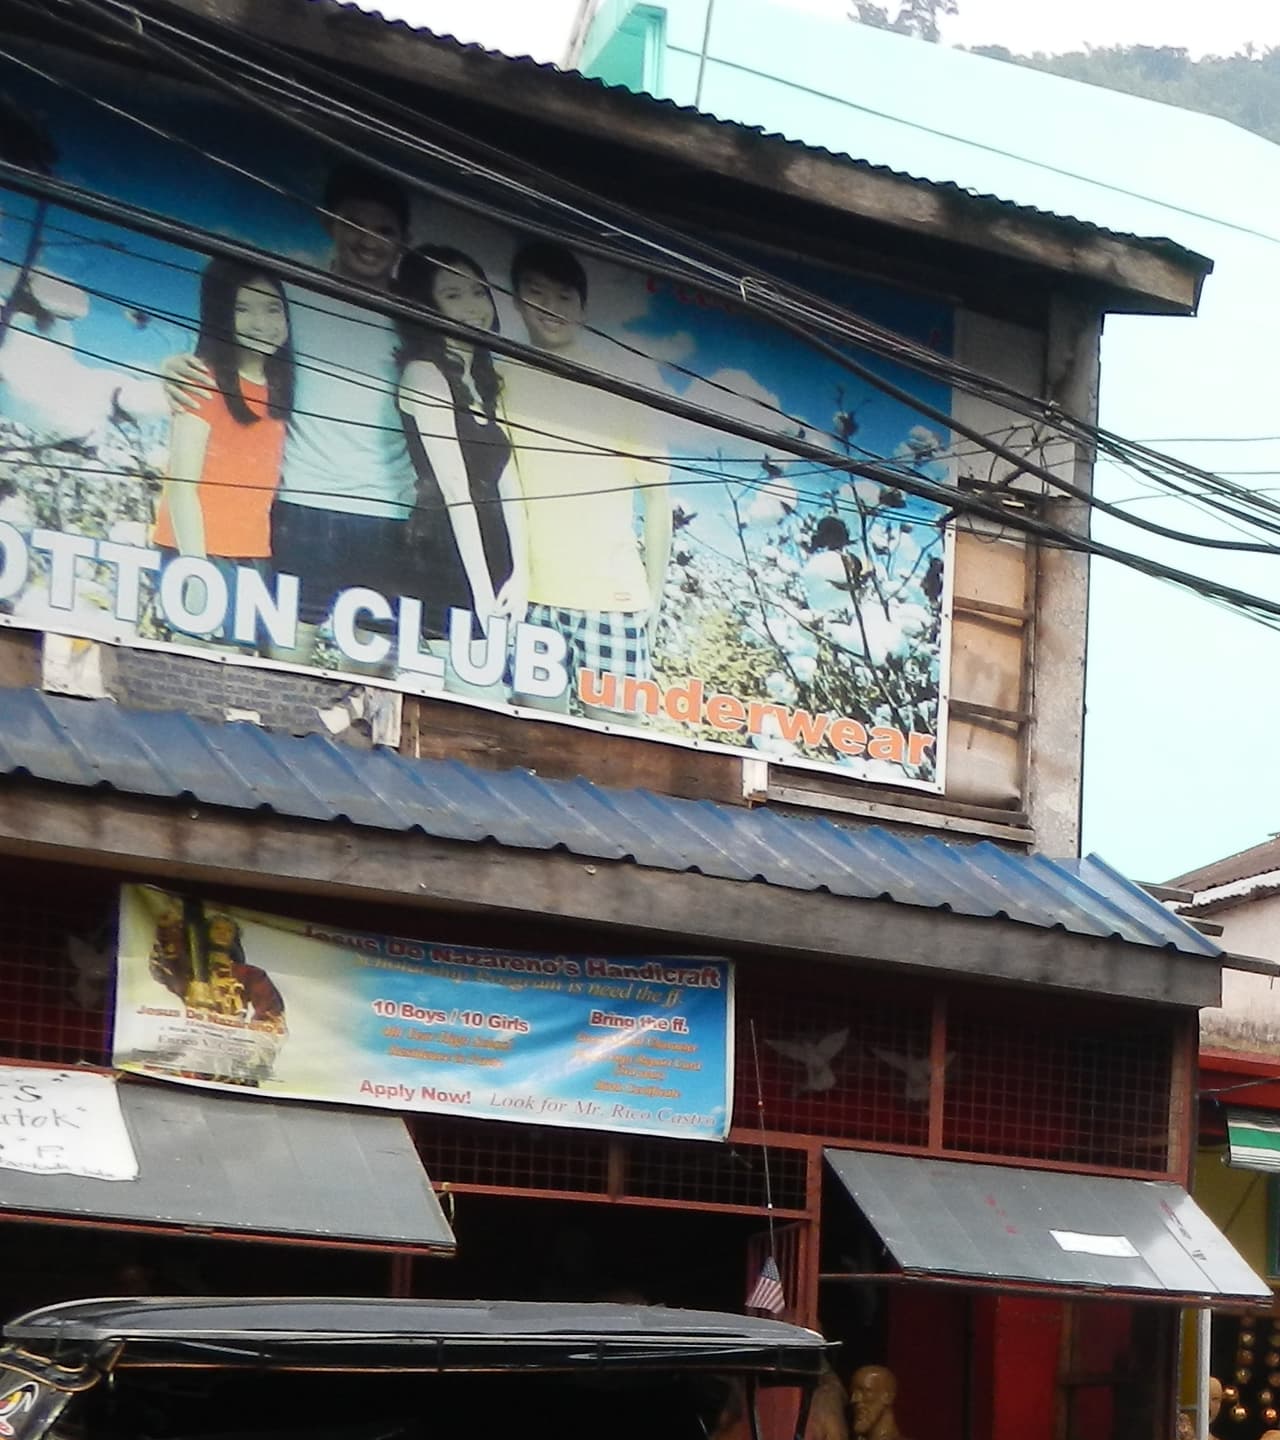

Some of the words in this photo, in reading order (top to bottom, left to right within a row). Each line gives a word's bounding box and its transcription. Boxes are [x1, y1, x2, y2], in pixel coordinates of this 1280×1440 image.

[333, 586, 568, 697] CLUB
[577, 667, 936, 765] underwear
[431, 949, 580, 977] Nazareno's
[586, 958, 720, 988] Handicraft
[588, 982, 632, 1000] need
[373, 999, 396, 1016] 10
[401, 1003, 447, 1024] Boys
[461, 1011, 483, 1027] 10
[488, 1013, 529, 1033] Girls
[590, 1010, 635, 1029] Bring
[360, 1079, 416, 1102] Apply
[421, 1085, 472, 1104] Now!
[490, 1093, 535, 1111] Look
[538, 1097, 568, 1114] for
[611, 1103, 652, 1121] Rico
